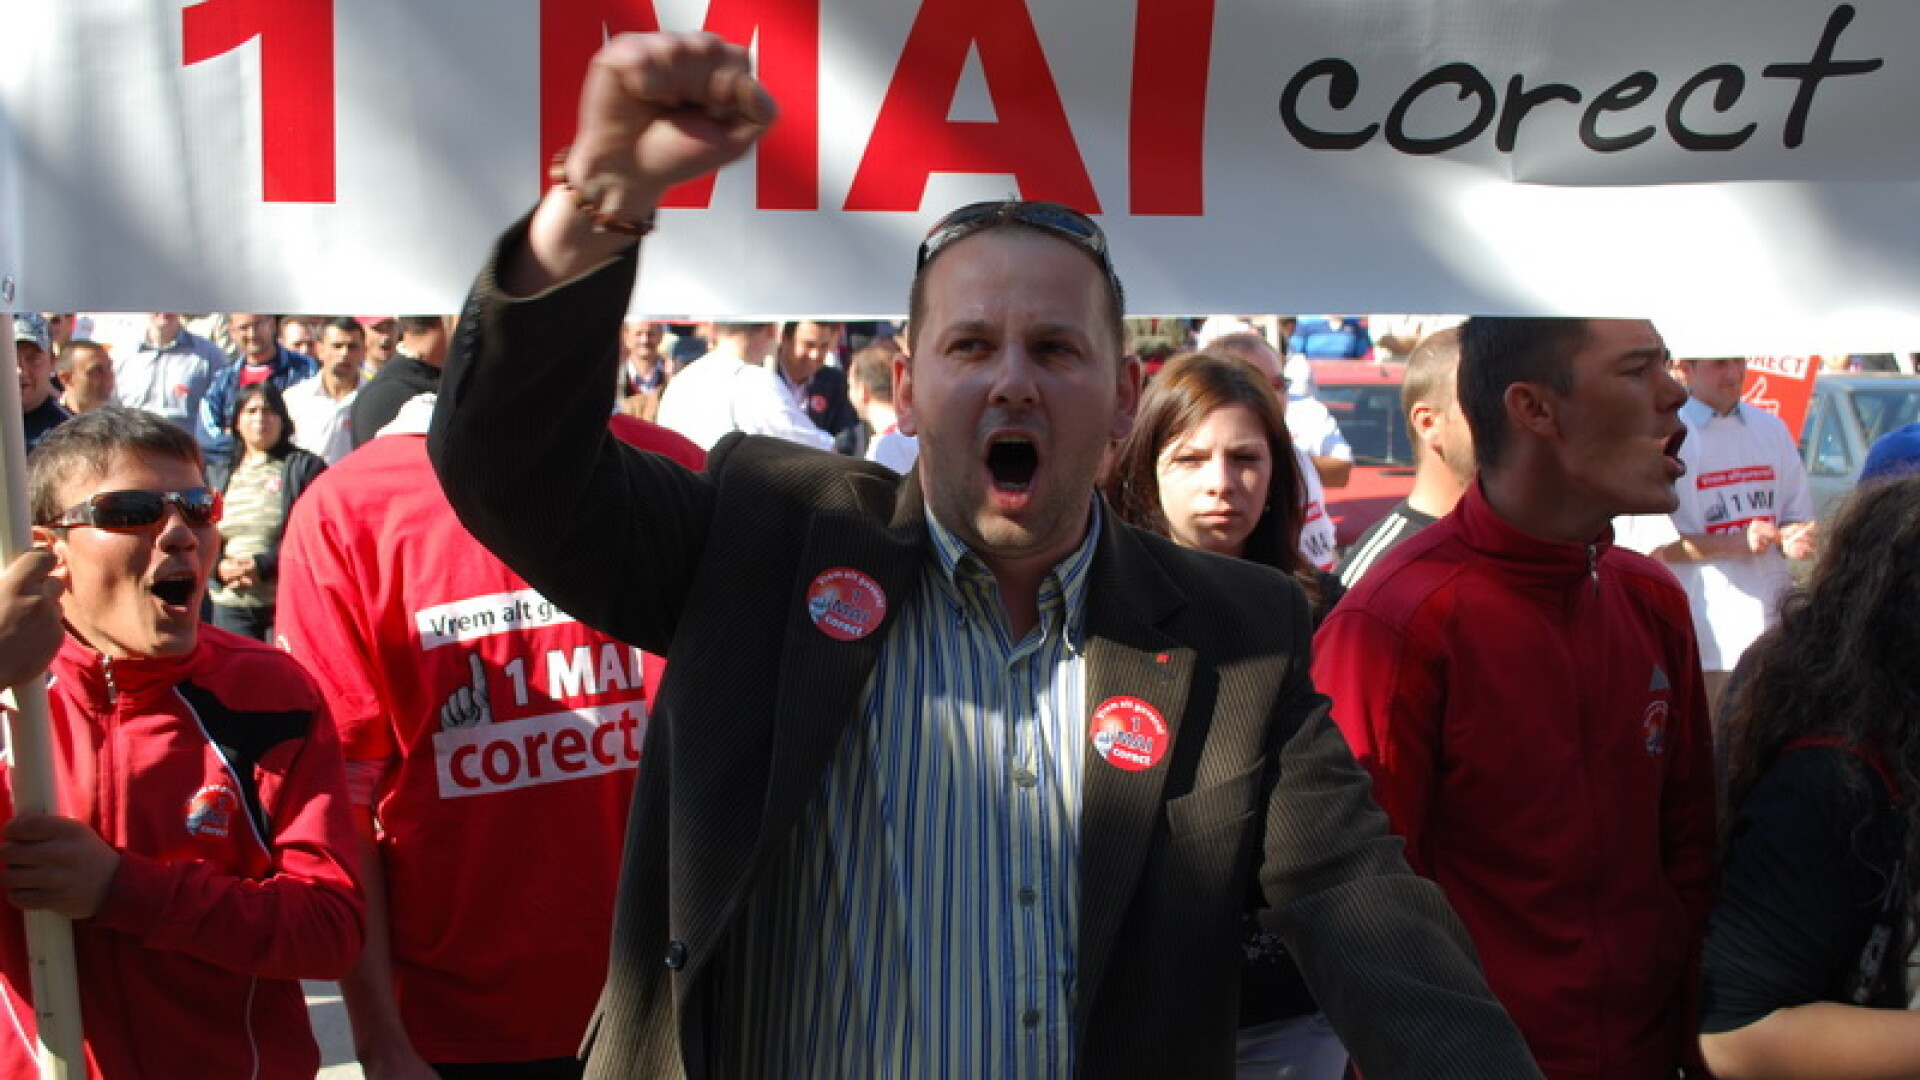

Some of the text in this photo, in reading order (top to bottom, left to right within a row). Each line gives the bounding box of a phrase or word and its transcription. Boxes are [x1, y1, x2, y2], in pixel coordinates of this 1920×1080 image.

[183, 0, 1885, 216] 1 MAI corect
[429, 608, 496, 637] Vrem
[503, 600, 532, 623] alt
[825, 614, 864, 637] corect
[828, 598, 872, 624] MAI
[505, 642, 644, 707] 1 MAI
[449, 708, 640, 789] corect
[1112, 748, 1152, 767] corect
[1114, 731, 1153, 754] MAI
